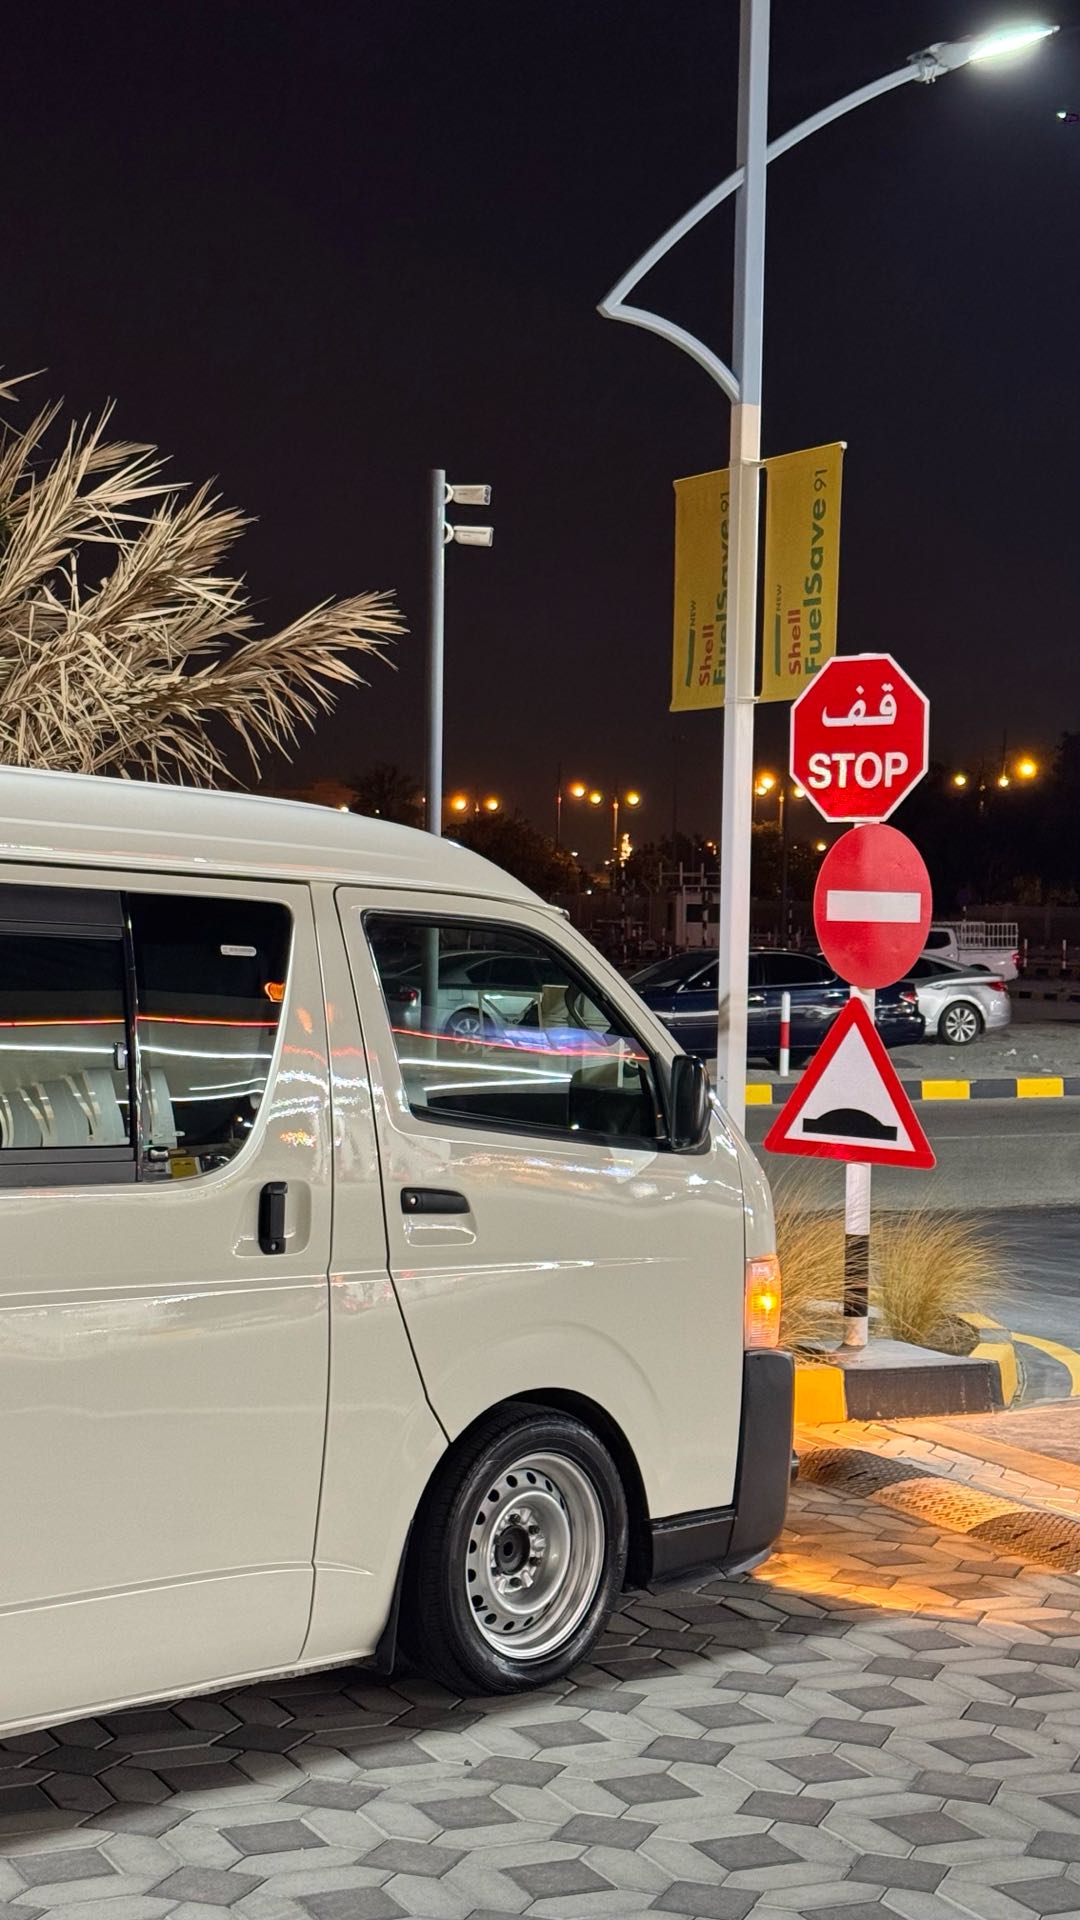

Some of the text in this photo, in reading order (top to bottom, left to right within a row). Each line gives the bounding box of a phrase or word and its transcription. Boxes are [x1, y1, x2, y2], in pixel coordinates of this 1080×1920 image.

[803, 469, 828, 675] FuelSave 91
[699, 624, 714, 686] Shell
[787, 609, 801, 675] Shell
[821, 682, 898, 728] قف
[808, 751, 909, 789] STOP
